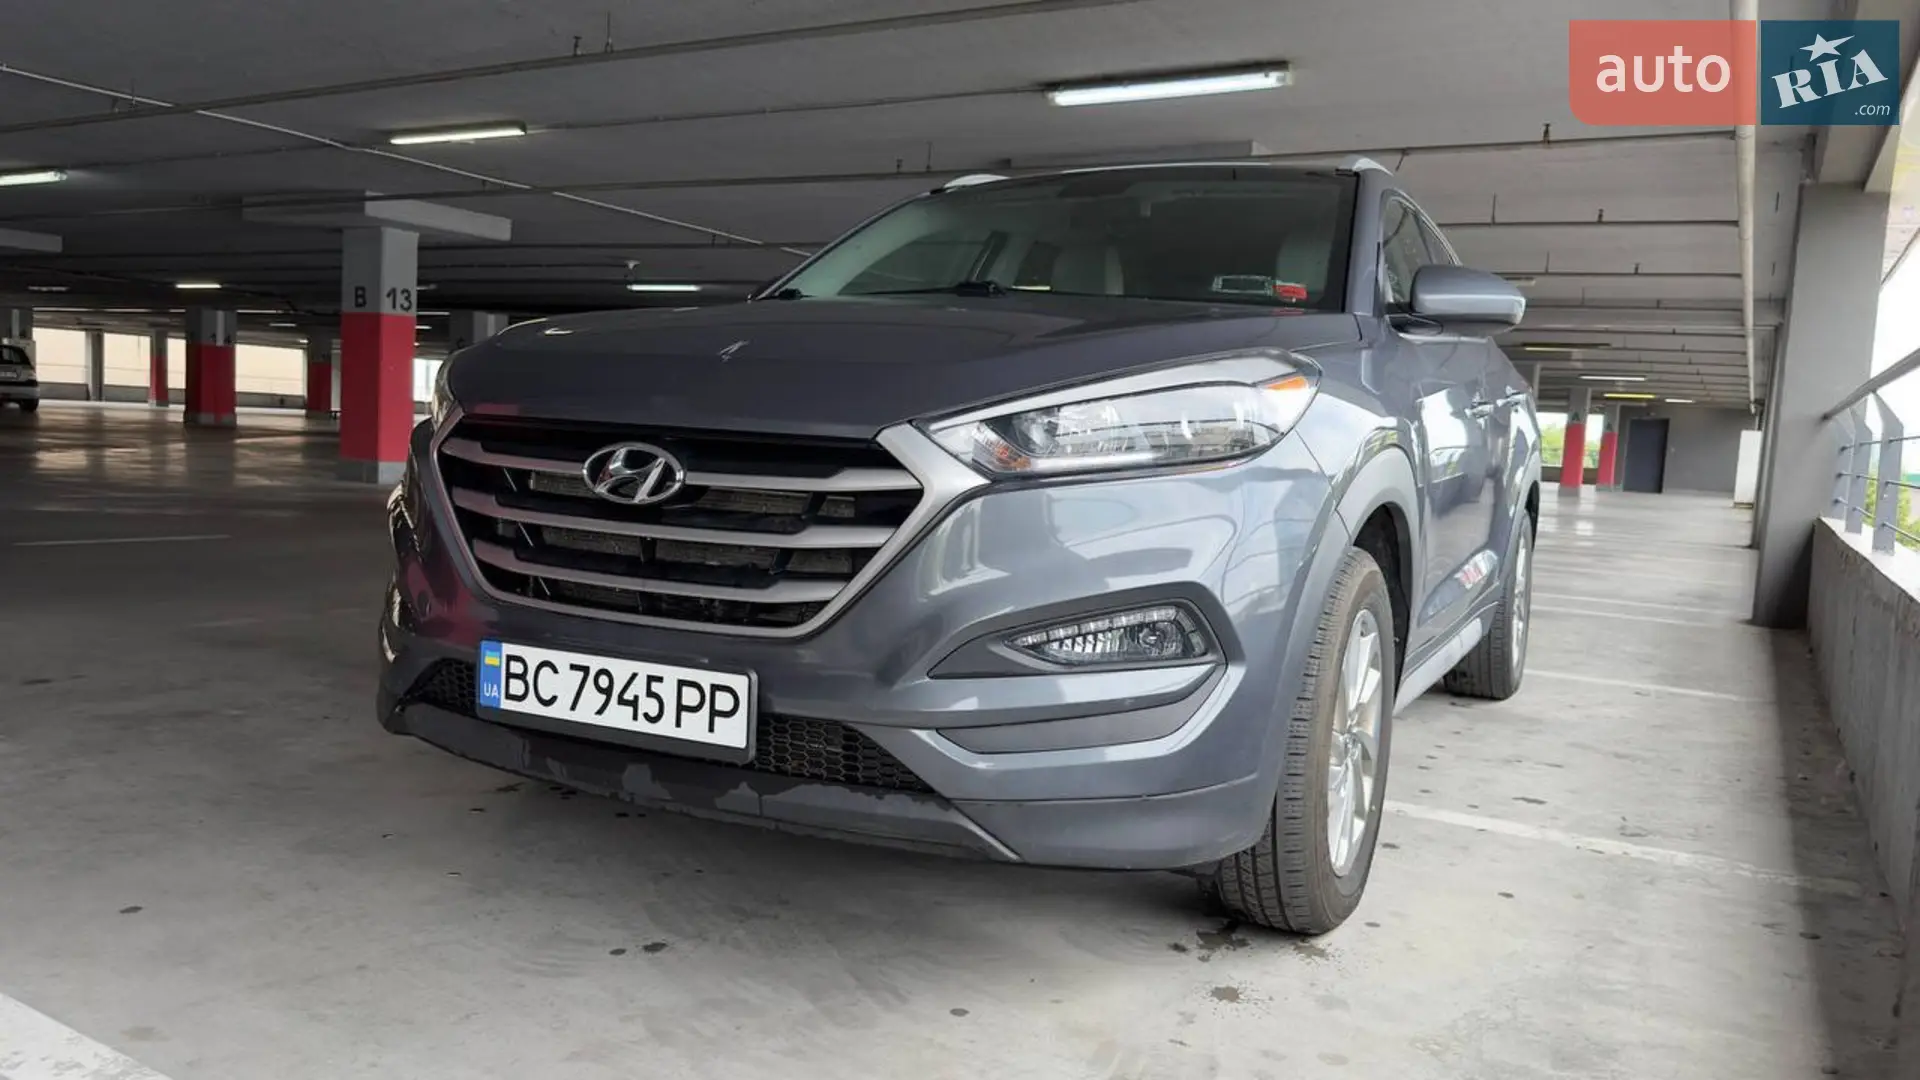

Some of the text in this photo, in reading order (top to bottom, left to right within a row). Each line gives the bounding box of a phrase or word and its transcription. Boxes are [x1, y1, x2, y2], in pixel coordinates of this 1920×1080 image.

[354, 286, 412, 312] B 13
[483, 682, 499, 698] UA
[505, 654, 740, 733] BC 7945 PP
